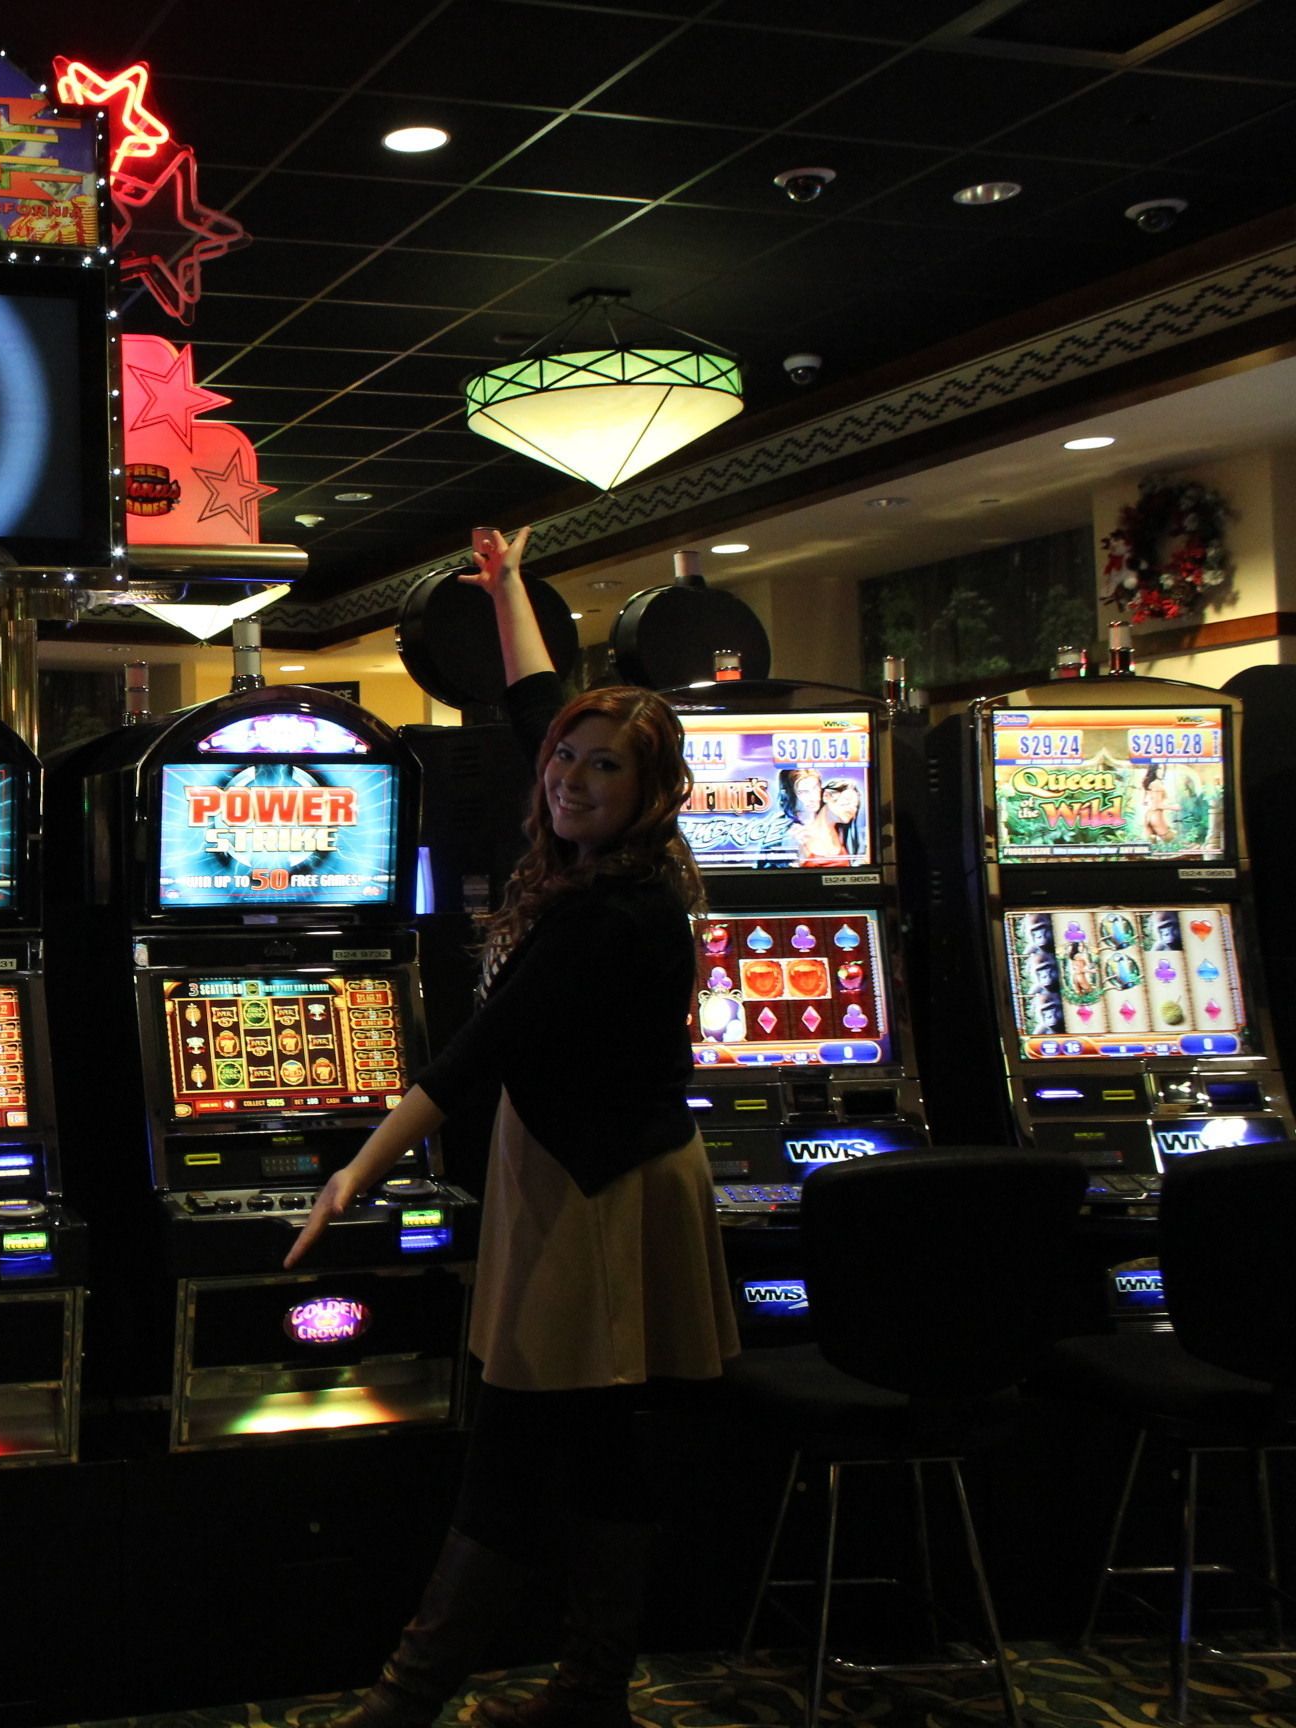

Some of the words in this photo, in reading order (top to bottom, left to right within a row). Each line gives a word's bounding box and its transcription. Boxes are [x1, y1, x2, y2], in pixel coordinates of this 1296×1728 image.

[125, 480, 181, 500] onus
[684, 740, 723, 761] 4.44
[777, 737, 849, 760] $370.54
[1019, 735, 1080, 756] $29.24
[1131, 733, 1203, 755] $296.28
[1012, 767, 1115, 798] Queen
[184, 786, 358, 827] POWER
[681, 777, 770, 814] MPIRE'S
[1018, 808, 1040, 819] the
[1039, 796, 1126, 829] Wild
[206, 827, 338, 853] STRIKE
[186, 876, 211, 888] WIN
[214, 876, 231, 888] UP
[234, 876, 250, 888] TO
[251, 868, 289, 890] 50
[291, 876, 319, 887] FREE
[188, 983, 199, 997] 3
[788, 1140, 874, 1161] WMS
[746, 1287, 804, 1303] WMS
[291, 1301, 363, 1325] GOLDEN
[297, 1322, 354, 1339] CROWN
